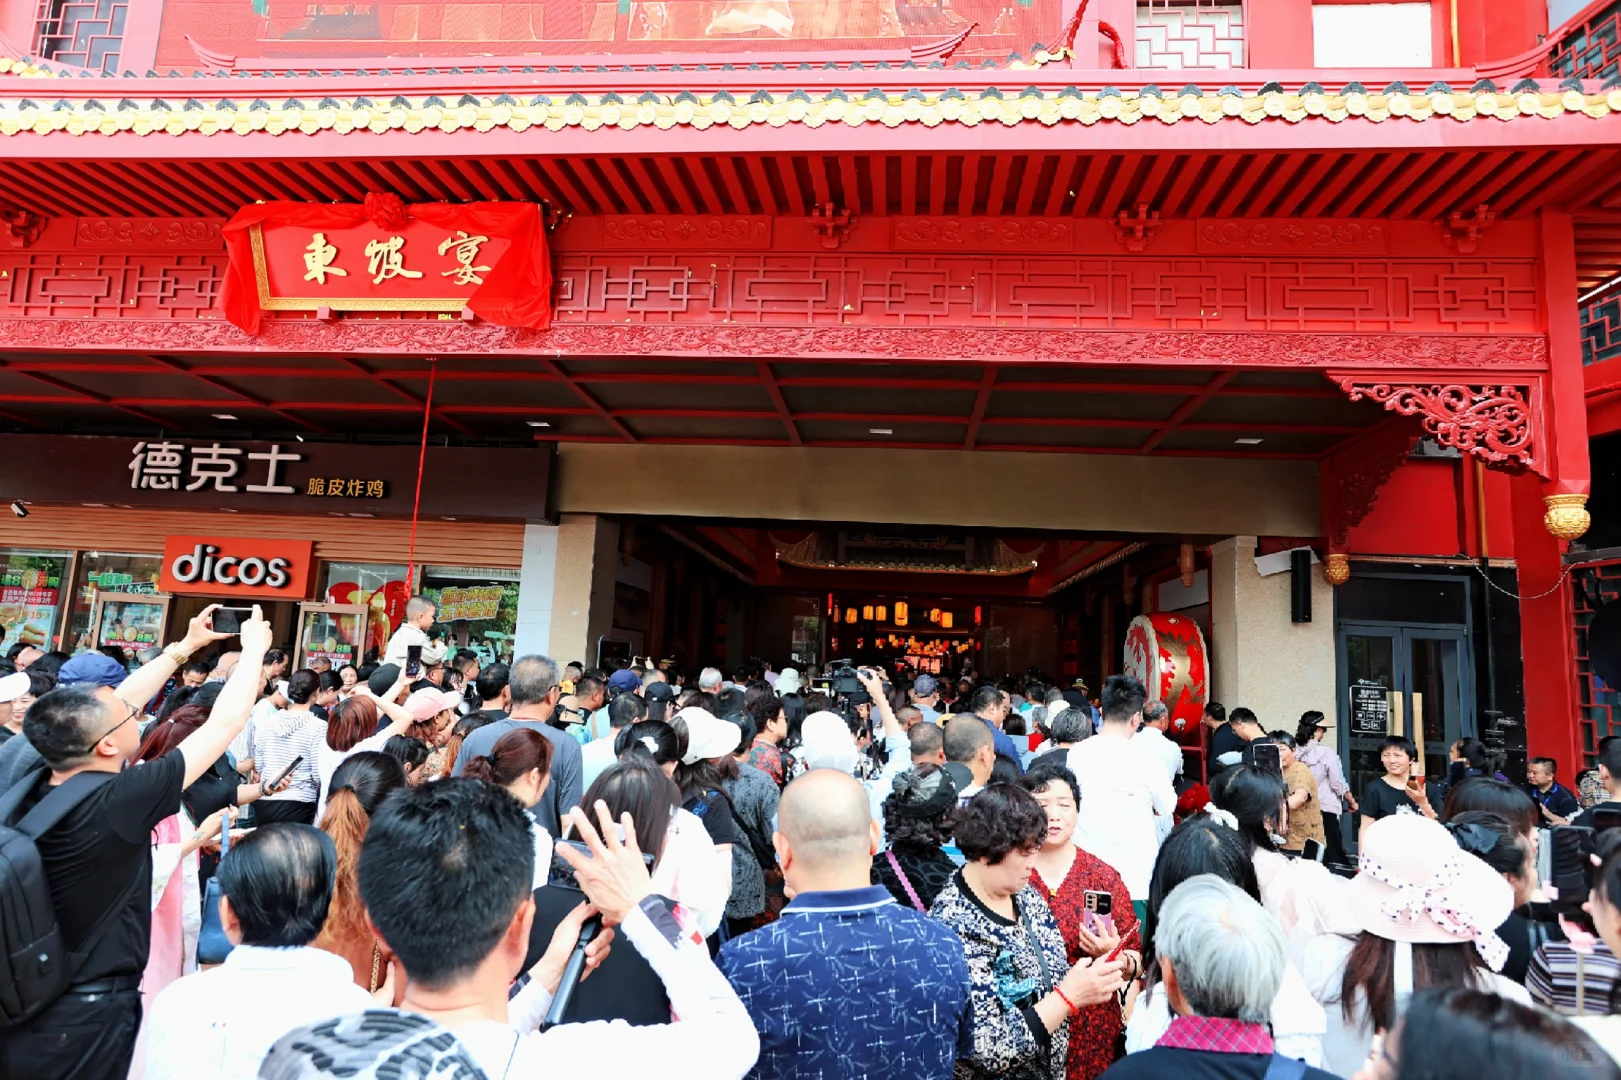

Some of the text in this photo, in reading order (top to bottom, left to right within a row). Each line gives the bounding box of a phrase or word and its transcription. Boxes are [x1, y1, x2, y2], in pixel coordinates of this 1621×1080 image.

[303, 230, 491, 285] 東坡宴
[128, 441, 301, 493] 德克士
[306, 478, 384, 498] 脆皮炸鸡
[171, 544, 288, 588] dicos
